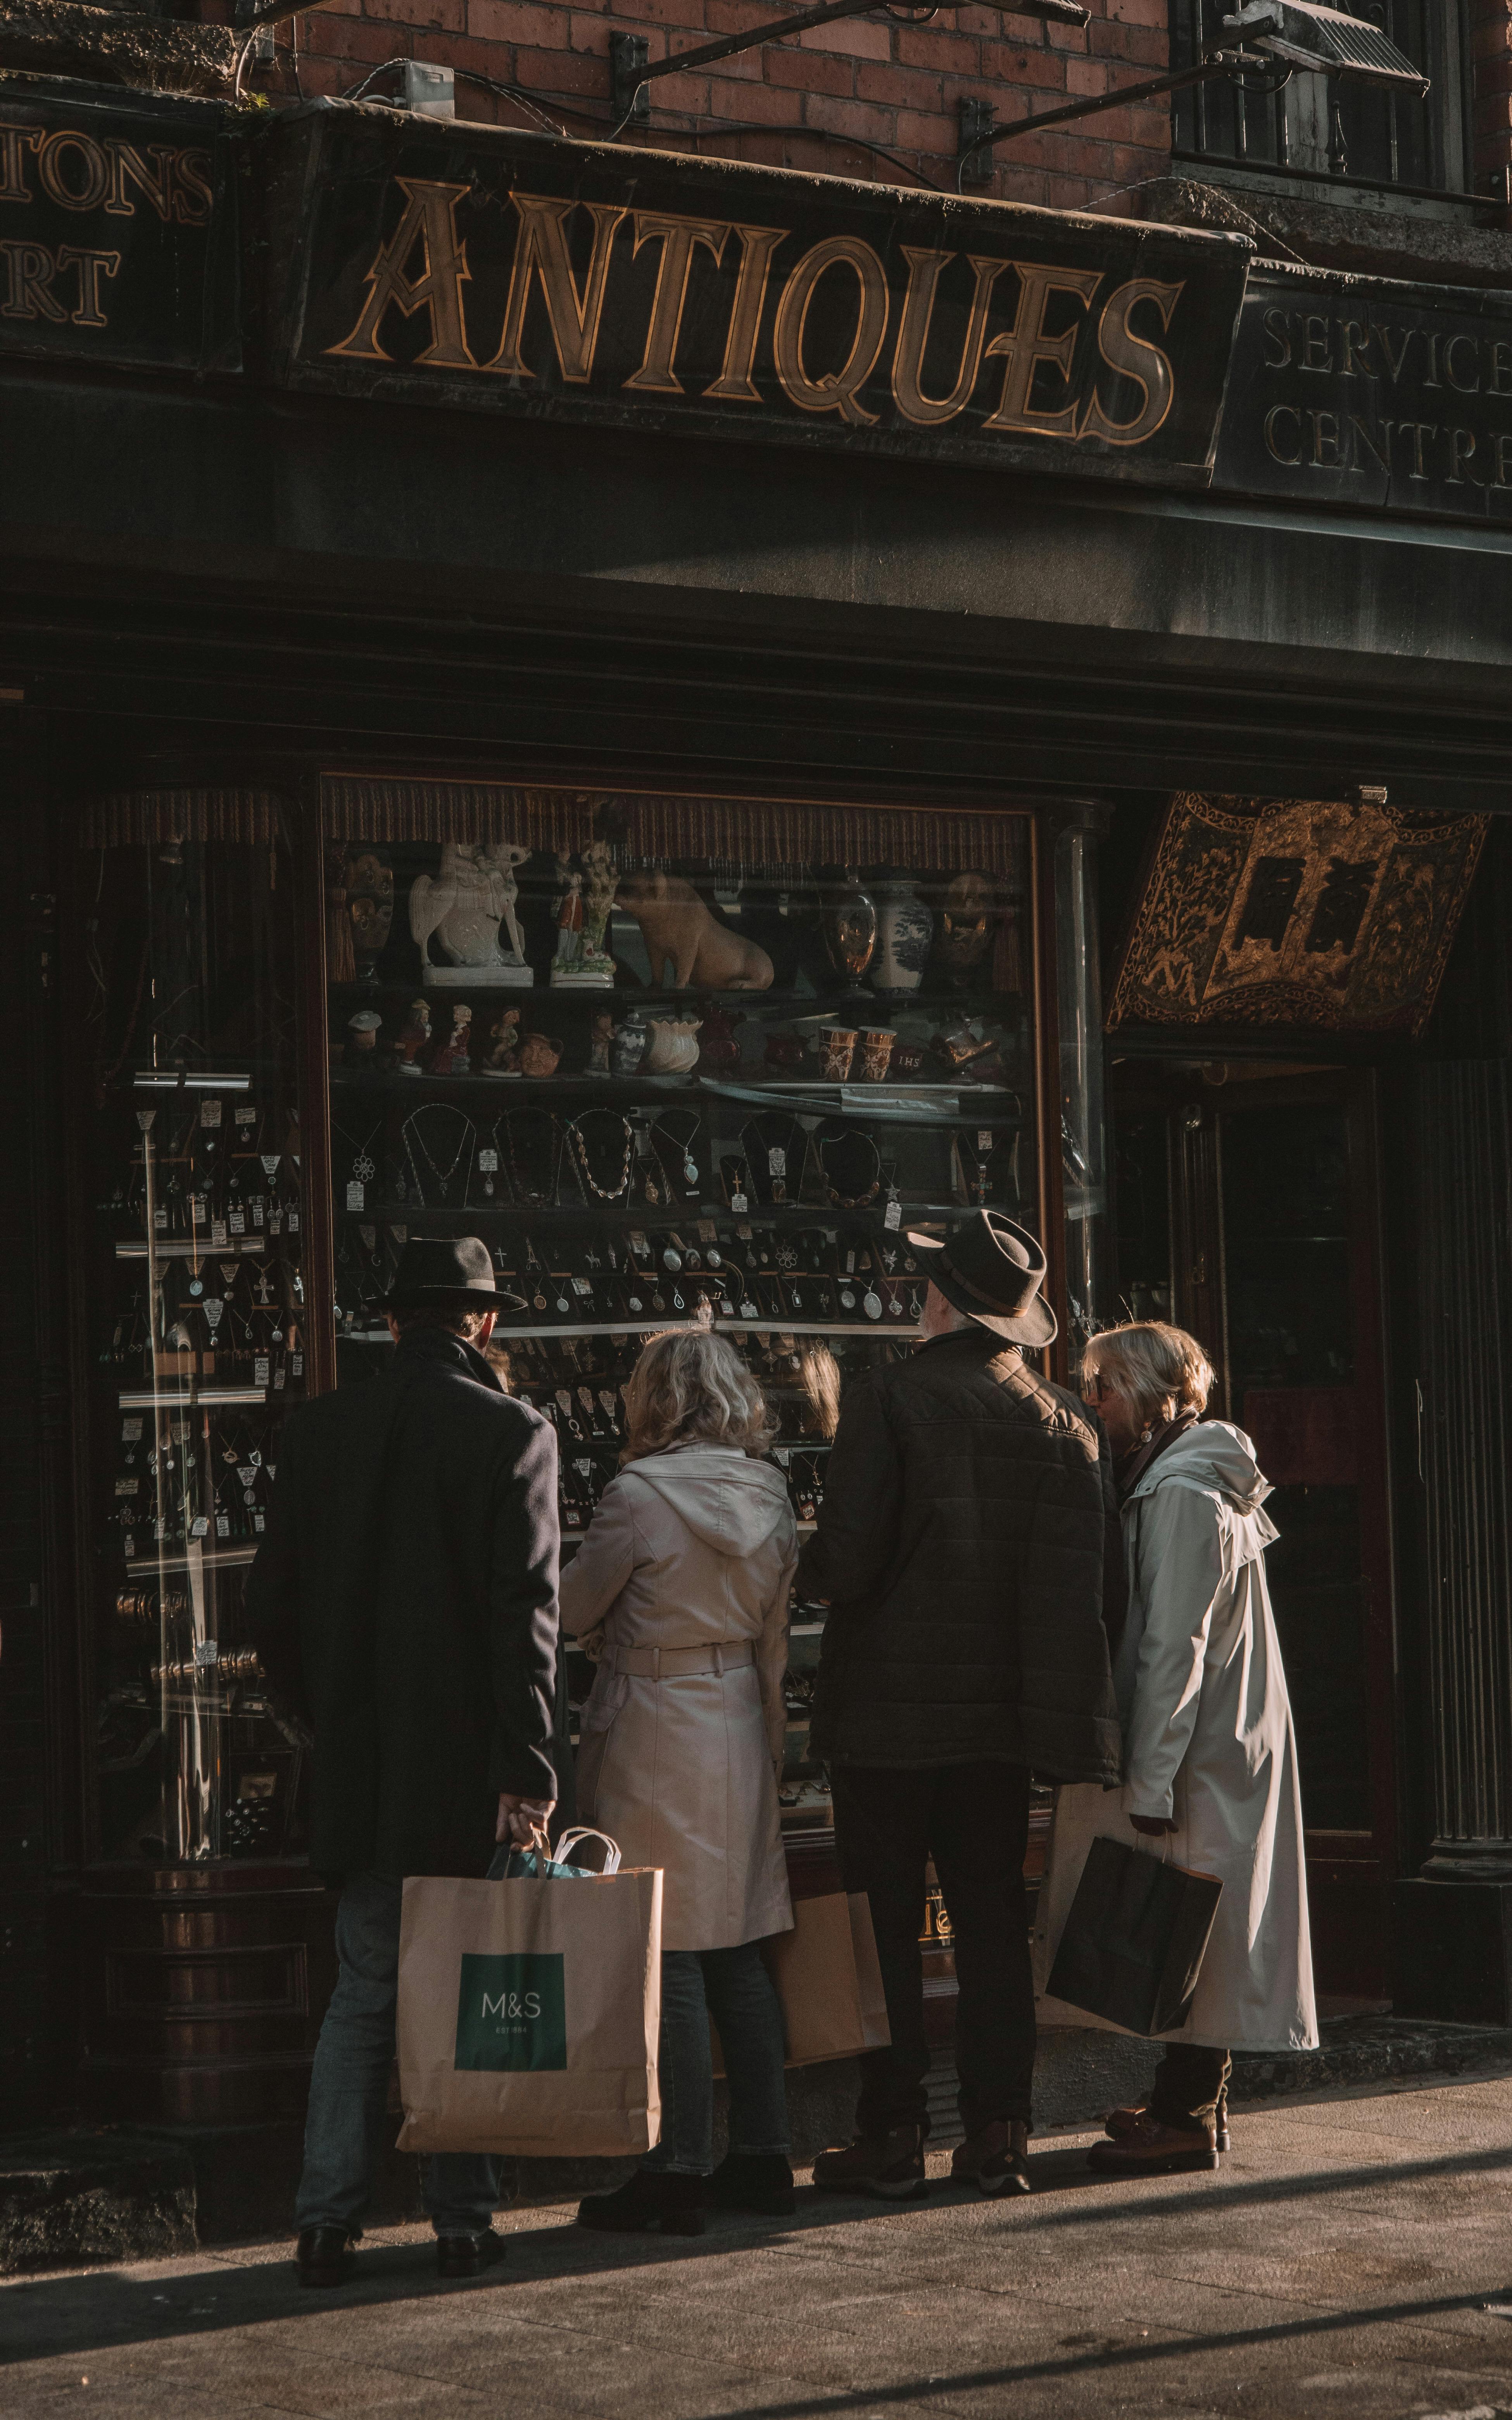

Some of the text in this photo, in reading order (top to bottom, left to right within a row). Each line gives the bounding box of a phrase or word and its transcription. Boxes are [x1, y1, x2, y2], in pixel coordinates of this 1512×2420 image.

[0, 239, 121, 327] RT
[323, 175, 1188, 446] ANTIQUES
[1262, 306, 1512, 396] SERVICE
[898, 1056, 920, 1067] IHS
[481, 1992, 540, 2019] M&S
